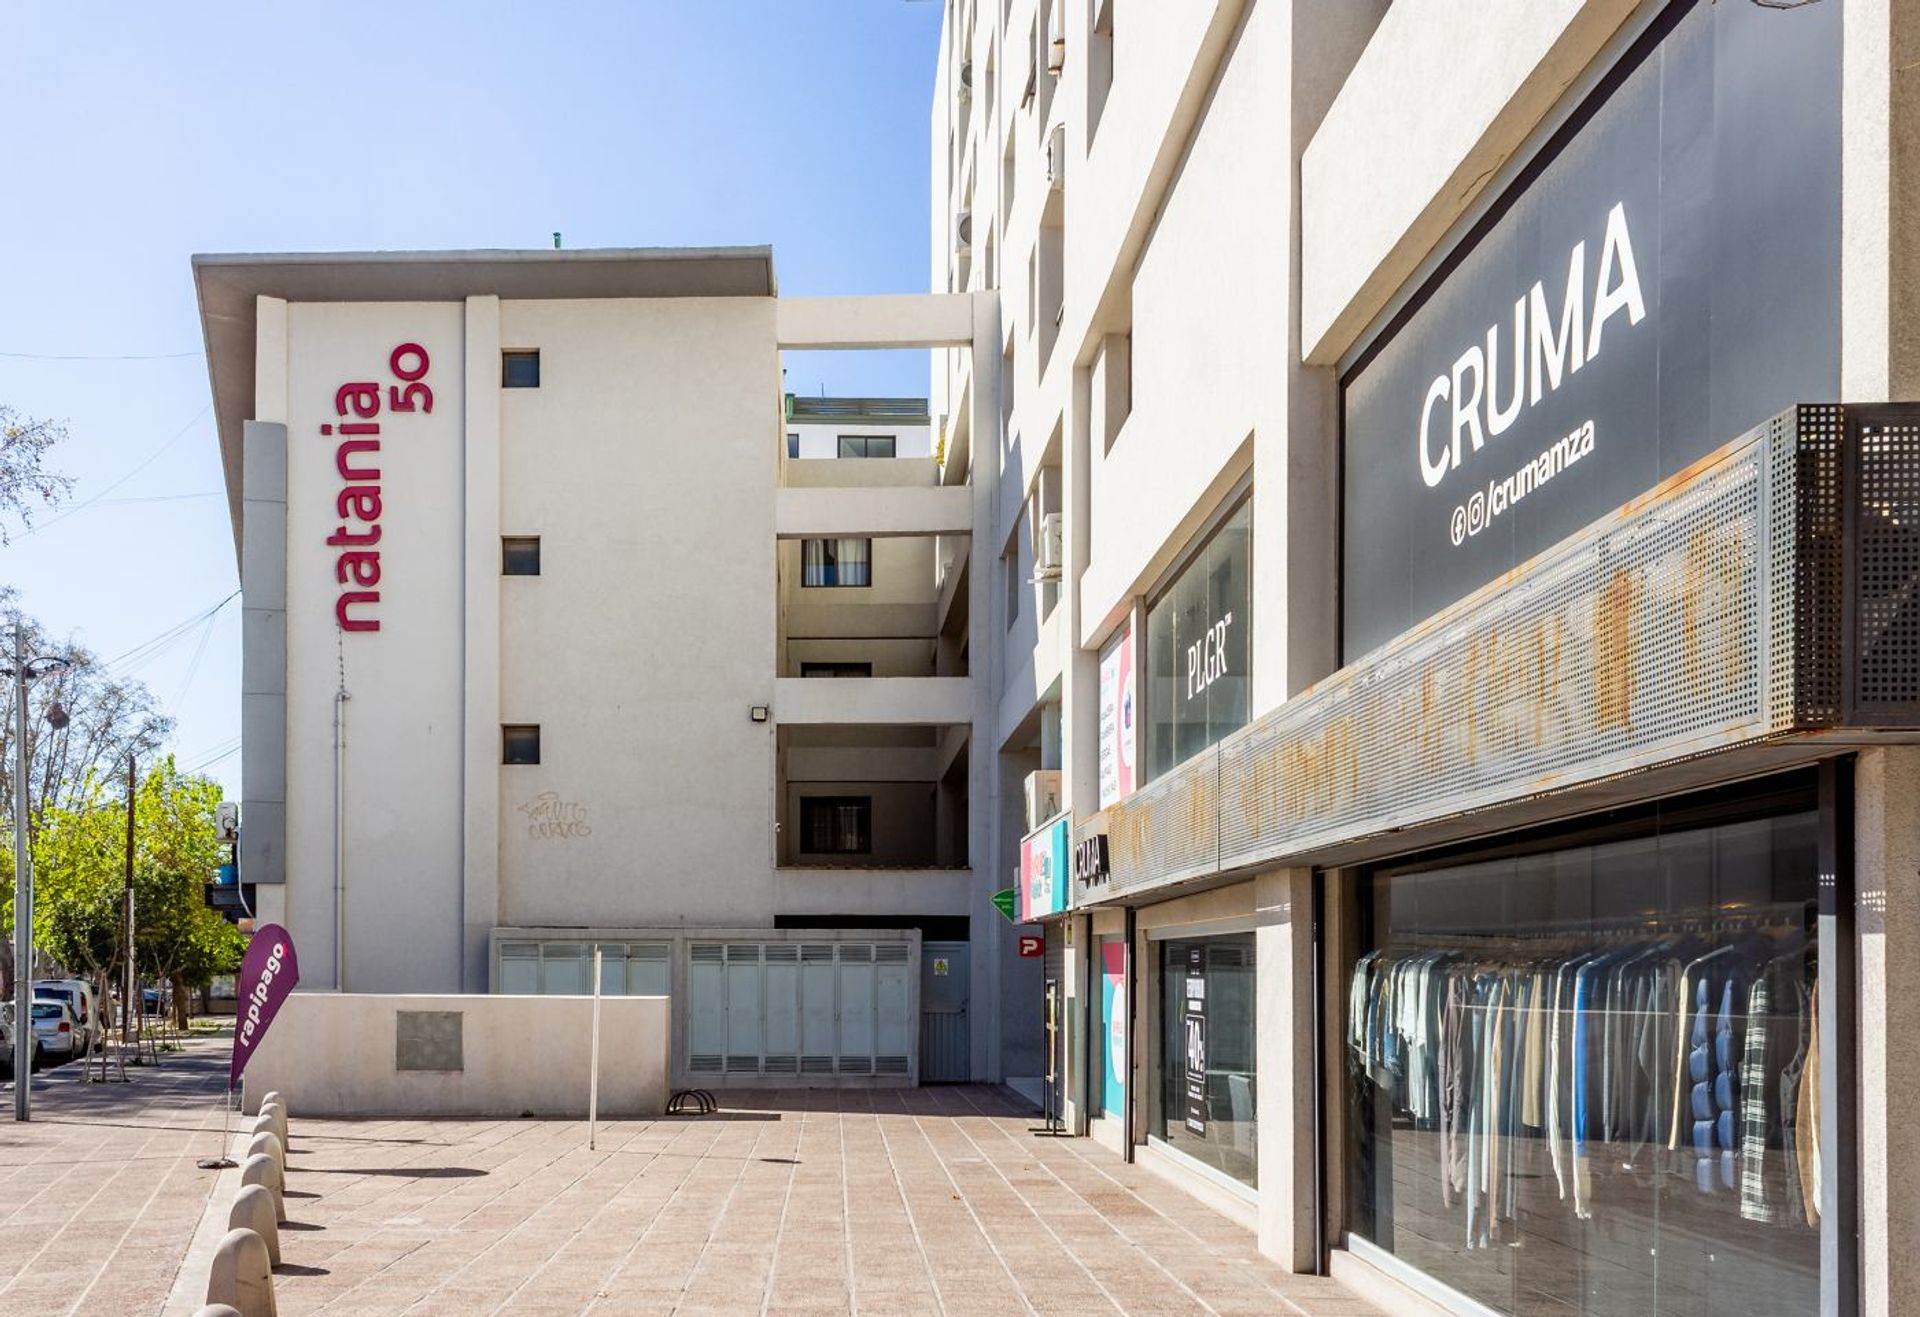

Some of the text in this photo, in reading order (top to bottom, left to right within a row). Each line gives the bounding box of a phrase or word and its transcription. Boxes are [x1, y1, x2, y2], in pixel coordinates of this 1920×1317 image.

[1419, 201, 1646, 487] CRUMA
[320, 382, 382, 632] natania
[240, 943, 284, 1046] rapipago
